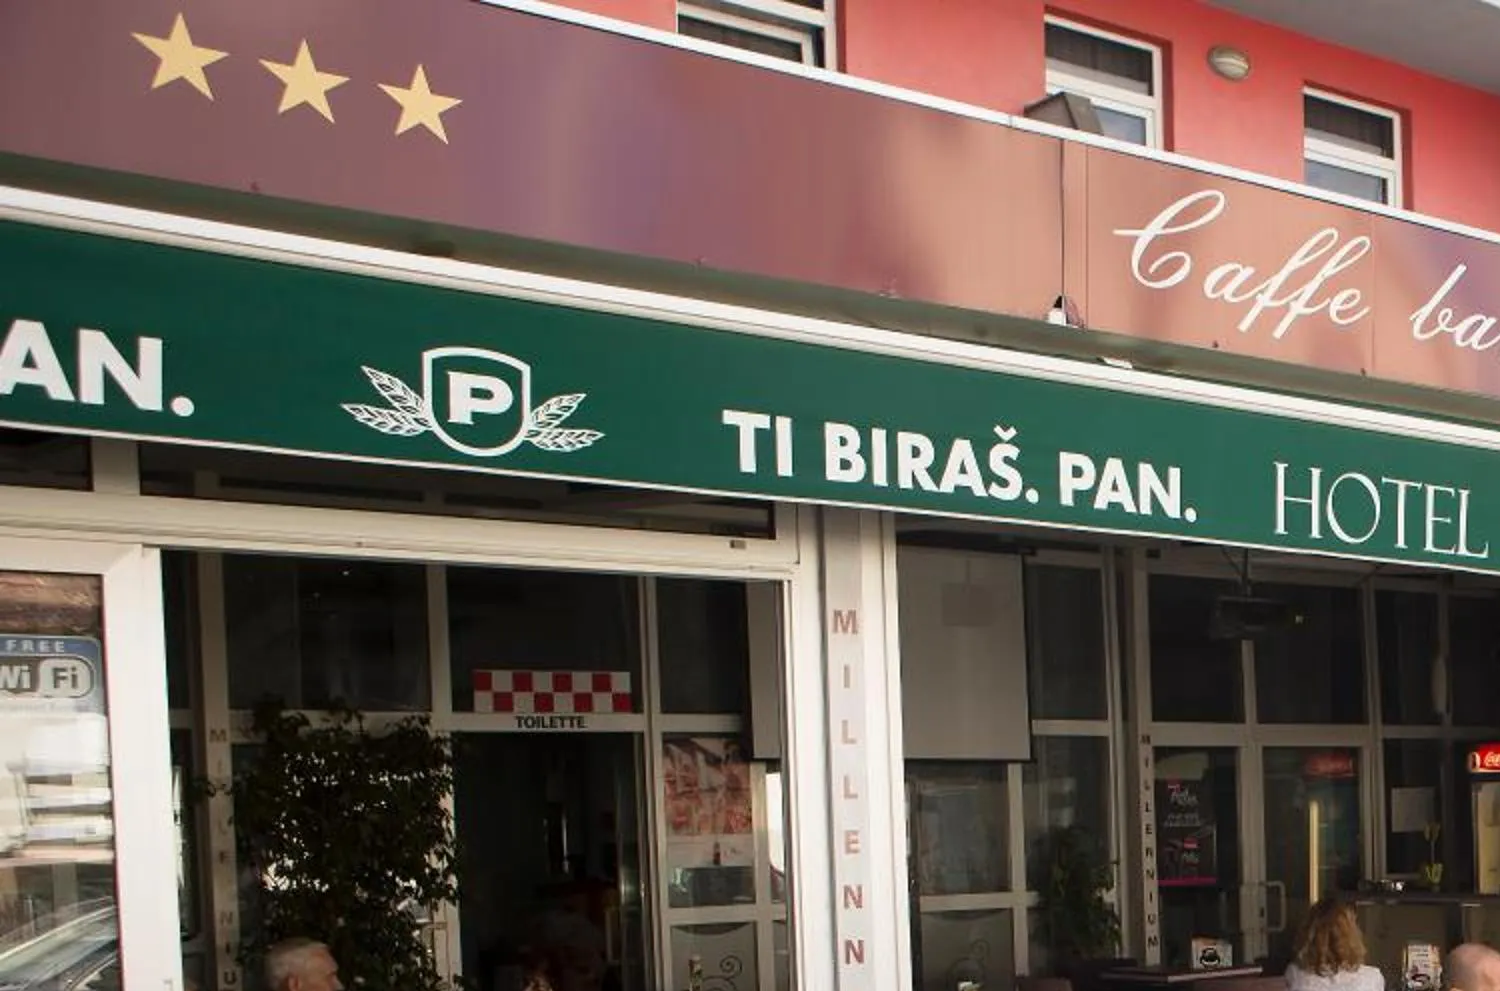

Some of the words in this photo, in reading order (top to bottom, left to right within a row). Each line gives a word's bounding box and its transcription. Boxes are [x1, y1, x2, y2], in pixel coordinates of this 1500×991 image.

[1112, 188, 1372, 340] Caffe
[721, 408, 795, 478] TI
[823, 421, 1040, 504] BIRAŠ.
[1057, 450, 1198, 523] PAN.
[1272, 461, 1489, 560] HOTEL
[5, 639, 65, 653] FREE
[515, 715, 589, 729] TOILETTE
